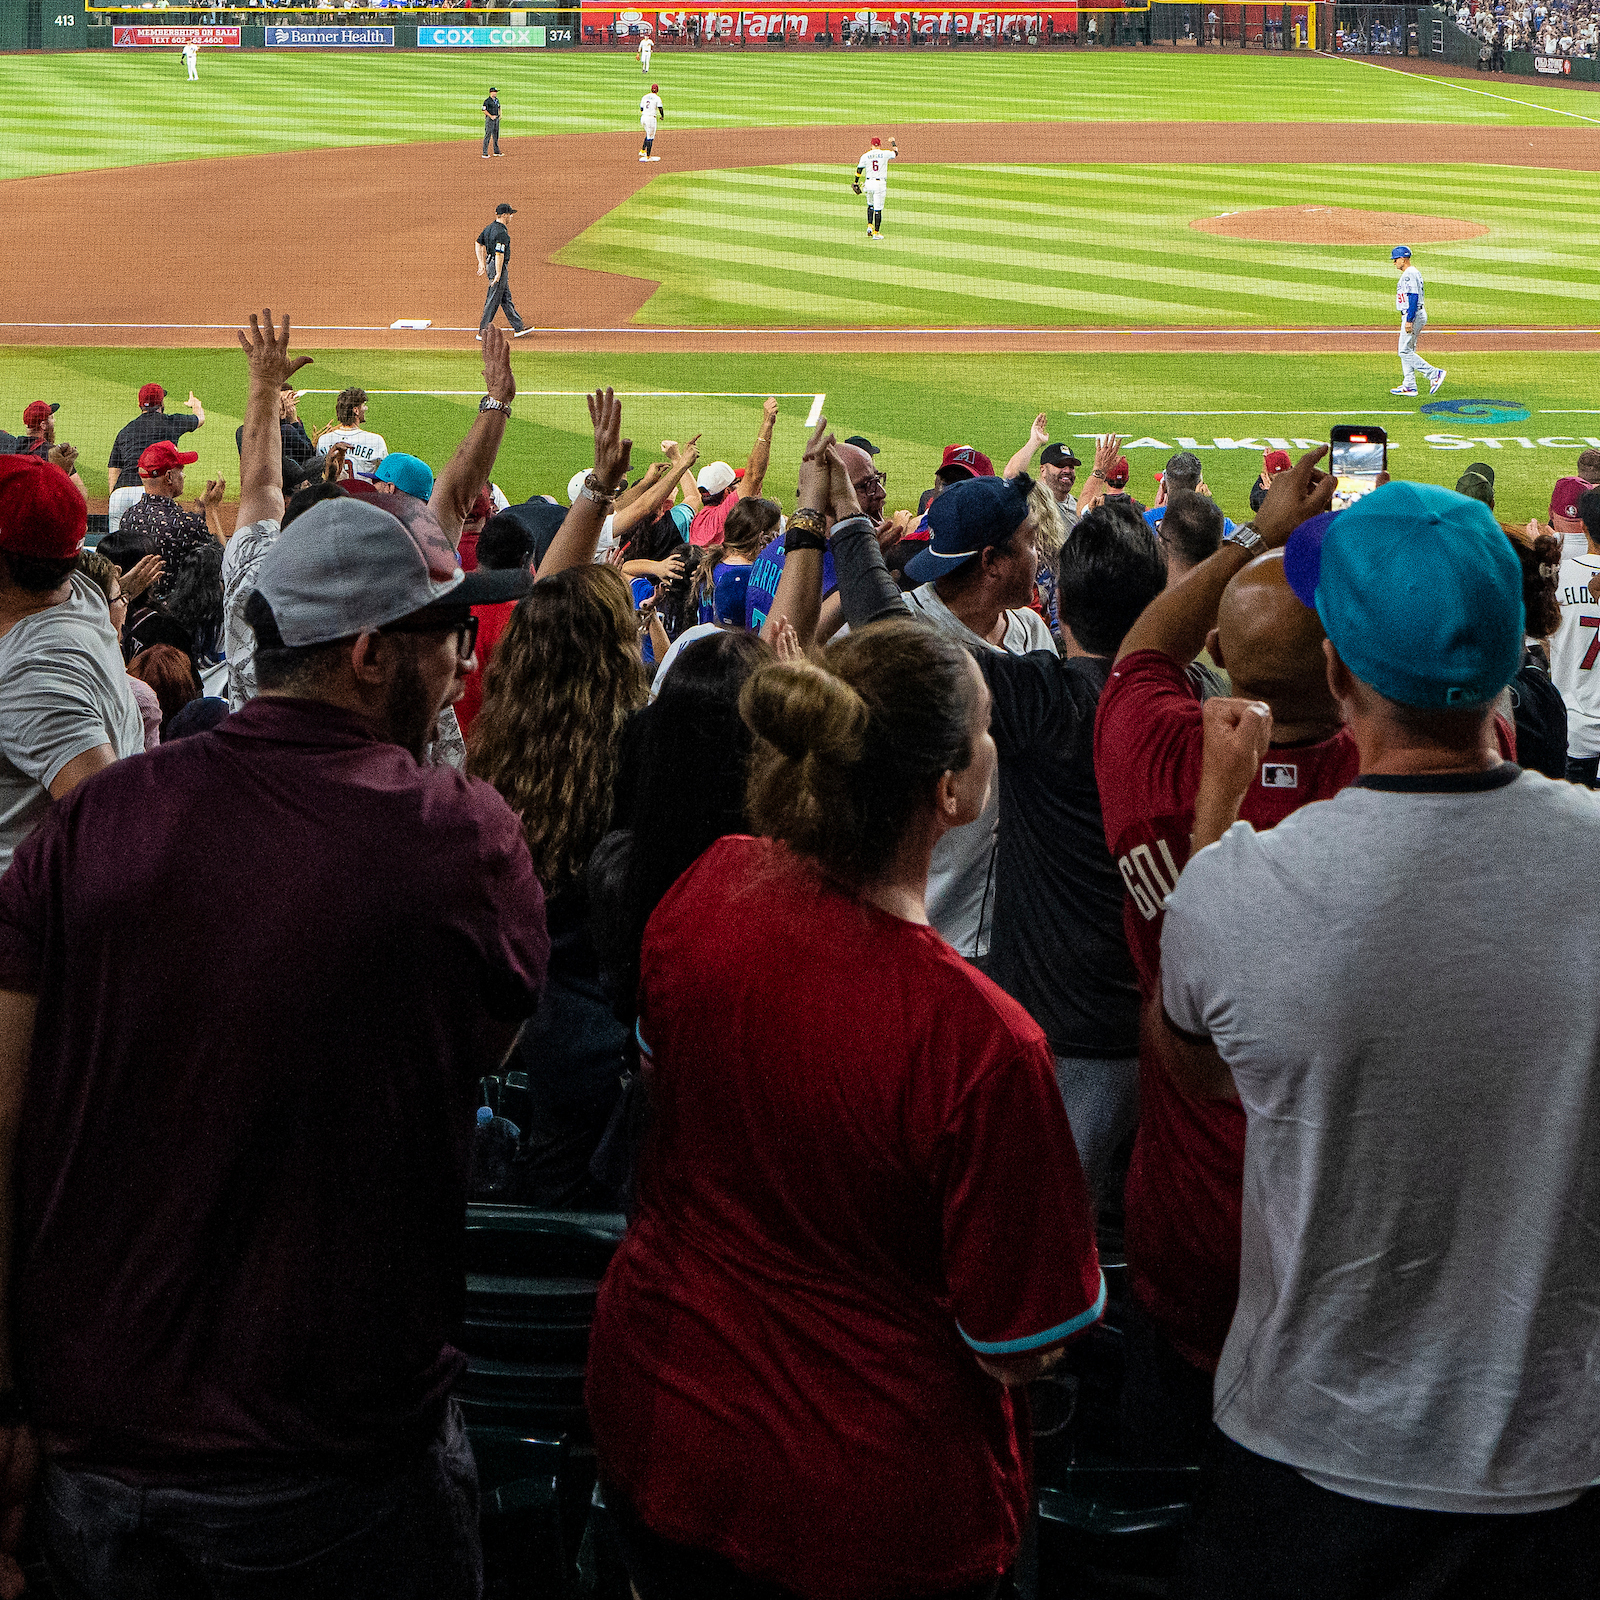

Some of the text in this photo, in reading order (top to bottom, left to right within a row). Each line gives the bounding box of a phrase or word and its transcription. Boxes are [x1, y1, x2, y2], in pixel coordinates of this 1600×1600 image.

[55, 15, 75, 27] 413
[291, 30, 384, 42] Banner Health
[432, 29, 474, 43] COX
[489, 29, 531, 43] COX
[550, 29, 571, 42] 374
[1073, 433, 1399, 450] TALKIN
